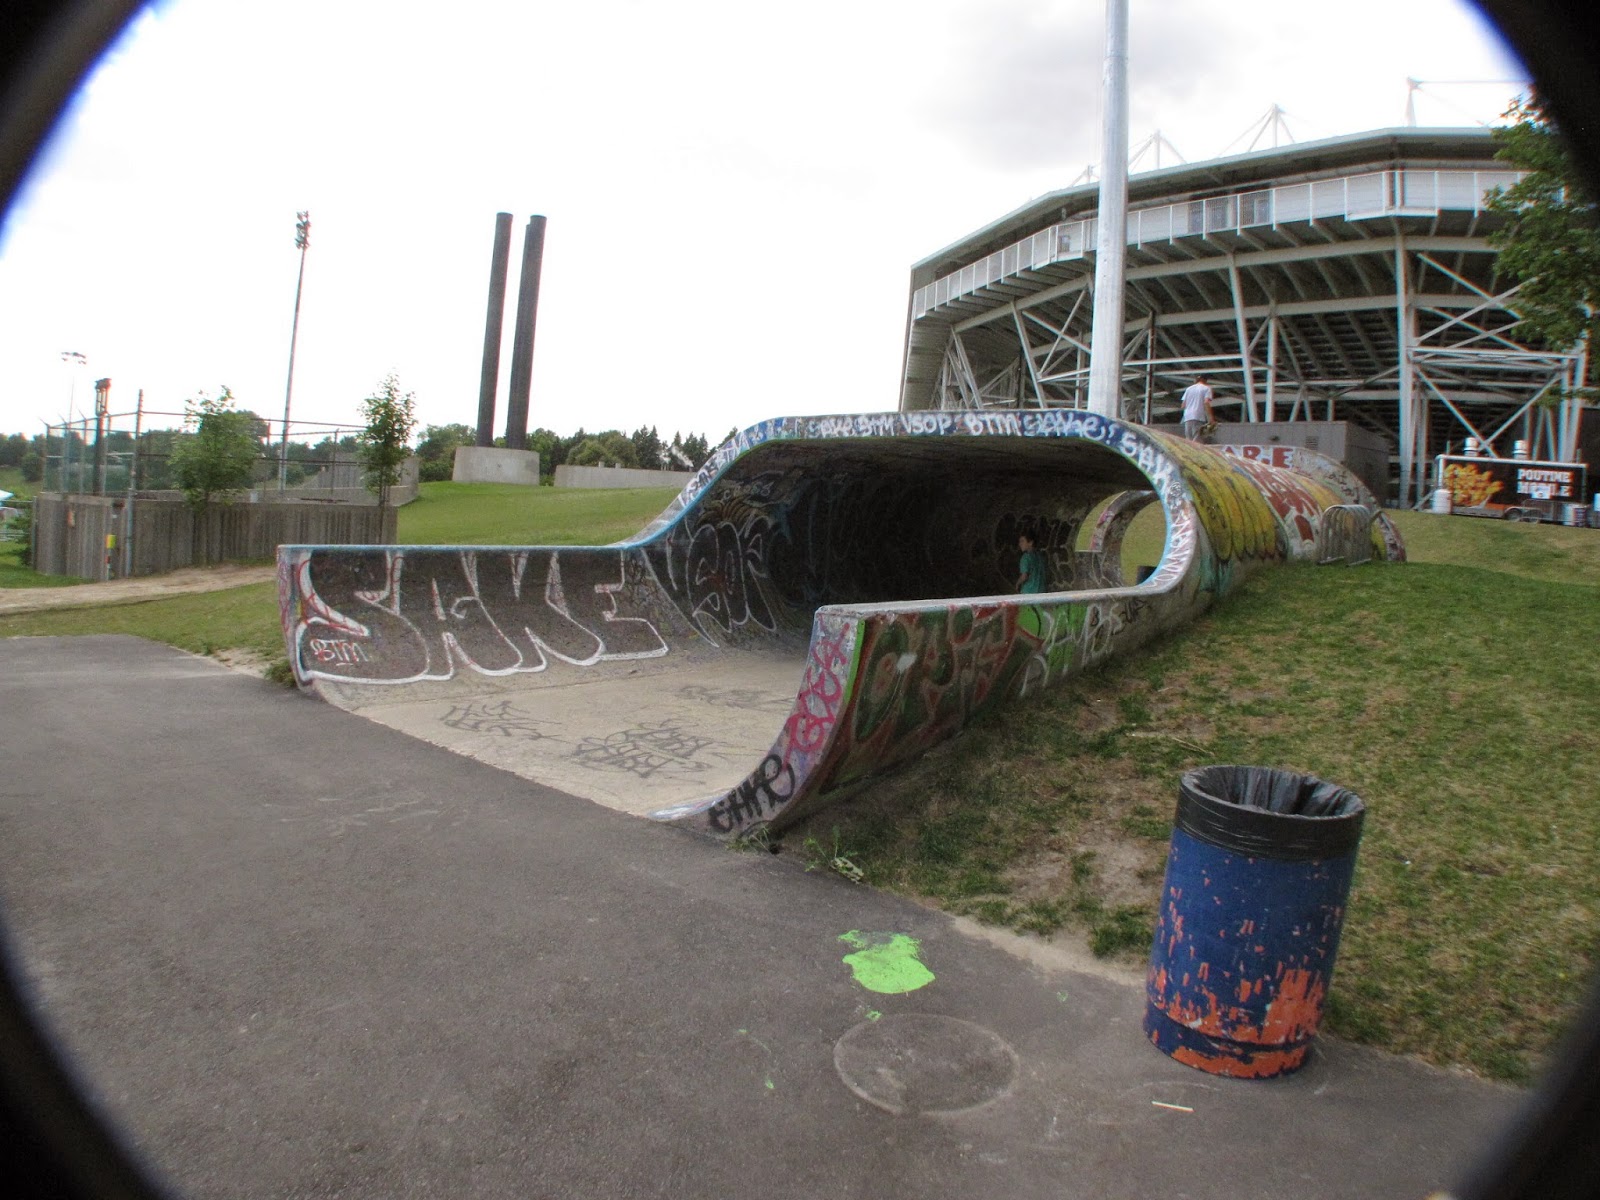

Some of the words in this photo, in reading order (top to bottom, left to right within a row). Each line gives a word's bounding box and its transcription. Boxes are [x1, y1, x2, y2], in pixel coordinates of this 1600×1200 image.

[900, 412, 951, 436] VSOP
[1517, 468, 1573, 483] POUTINE
[309, 638, 369, 663] BTM
